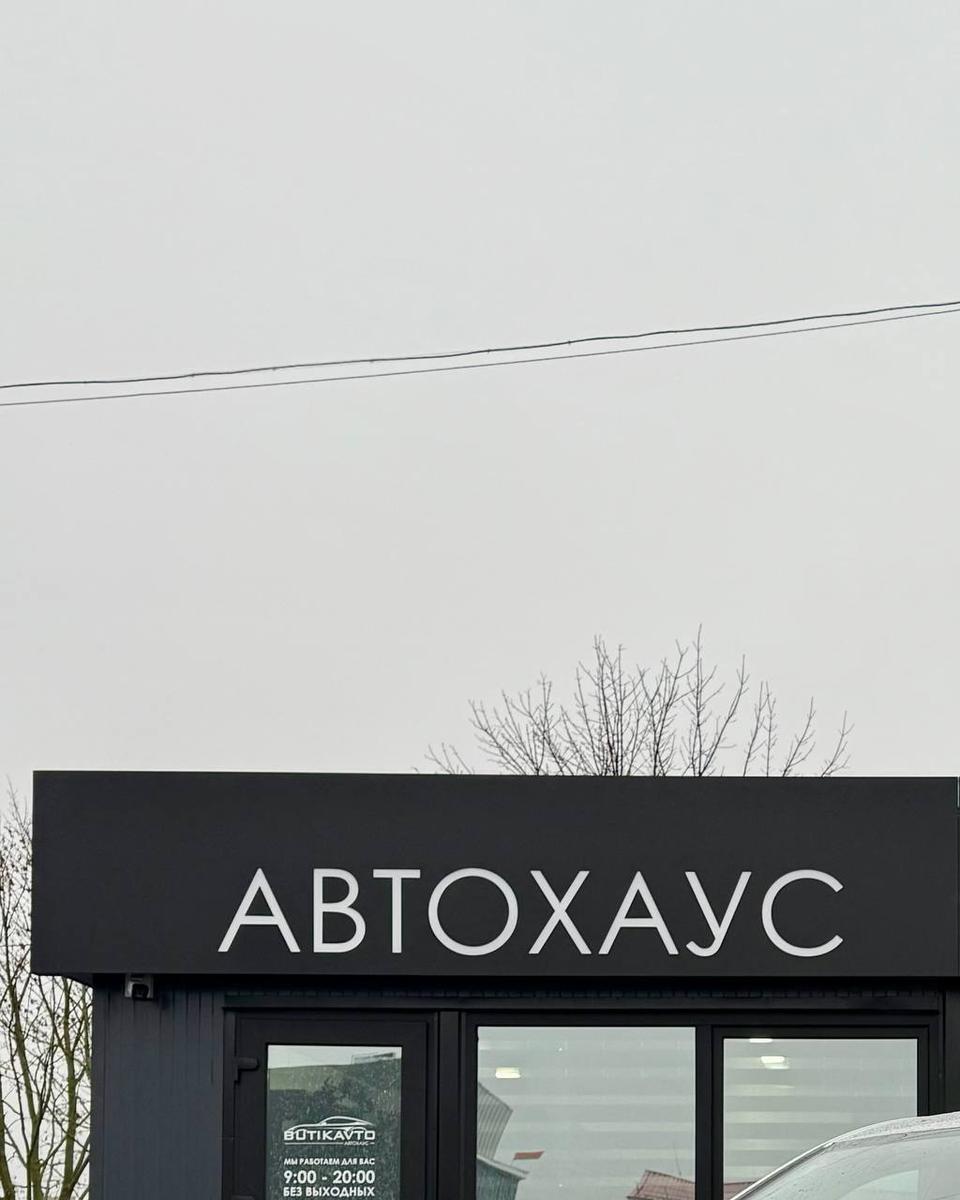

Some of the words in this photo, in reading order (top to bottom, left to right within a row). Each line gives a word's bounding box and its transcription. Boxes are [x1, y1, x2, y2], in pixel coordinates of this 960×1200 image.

[217, 866, 844, 958] АВТОХАУС
[283, 1129, 376, 1141] BUTIKAVTO
[341, 1158, 357, 1166] ДЛЯ
[283, 1170, 317, 1184] 9:00
[332, 1170, 376, 1184] 20:00
[283, 1187, 302, 1197] БЕЗ
[305, 1187, 375, 1198] ВЫХОДНЫХ
